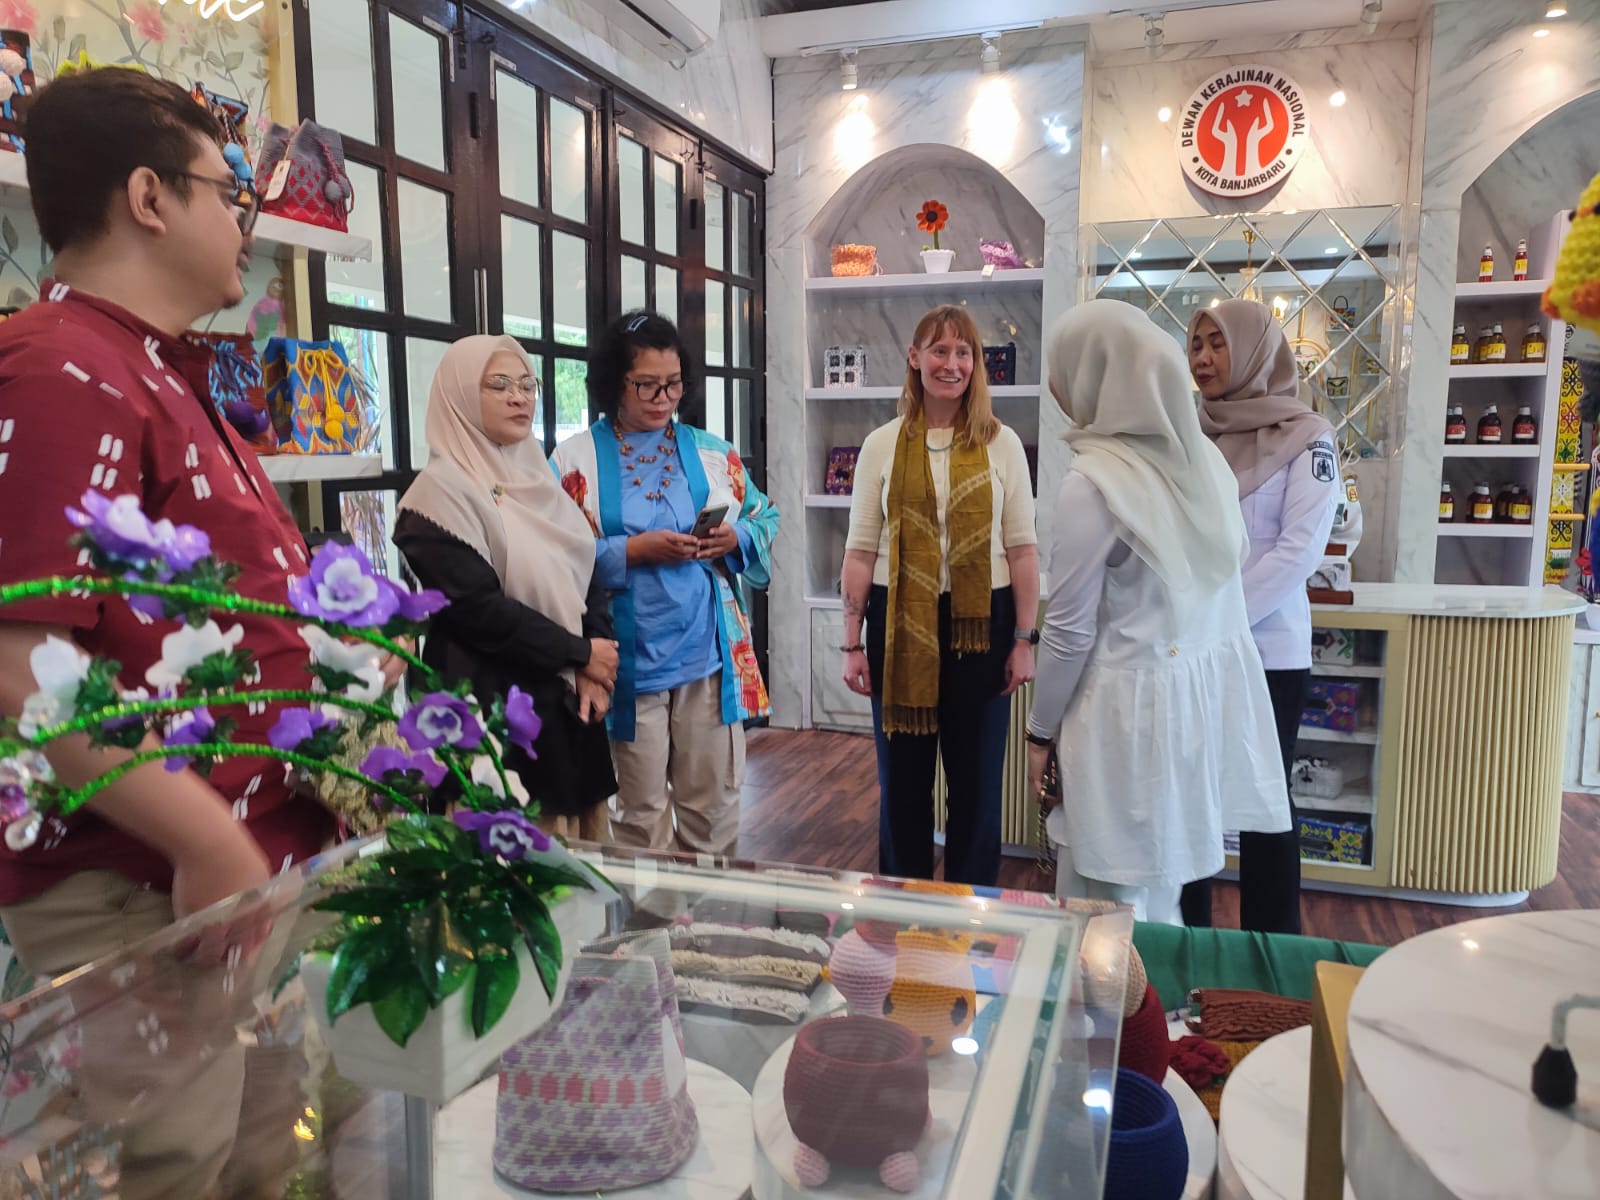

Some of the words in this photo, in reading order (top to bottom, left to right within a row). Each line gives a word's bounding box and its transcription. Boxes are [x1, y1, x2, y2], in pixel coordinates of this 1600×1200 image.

[1182, 100, 1203, 147] DEWAN
[1200, 69, 1274, 100] KERAJINAN
[1274, 78, 1305, 137] NASIONAL
[1195, 166, 1219, 187] KOTA
[1220, 160, 1286, 190] BANJARBARU
